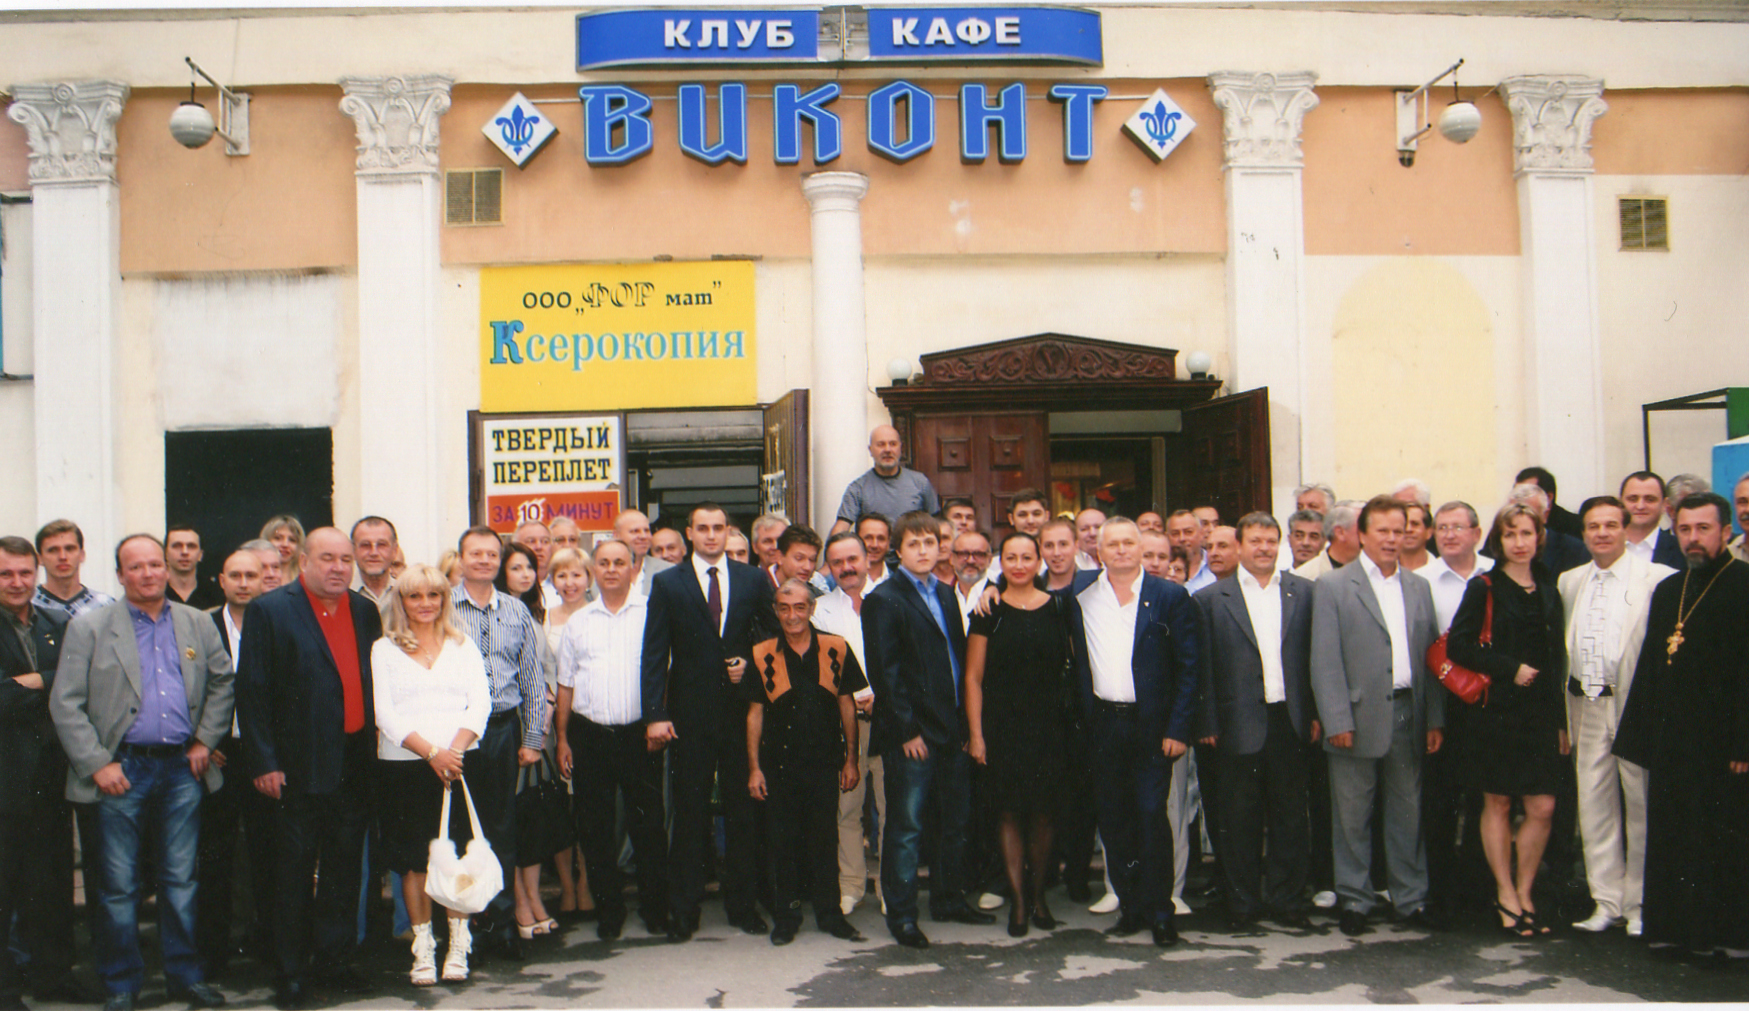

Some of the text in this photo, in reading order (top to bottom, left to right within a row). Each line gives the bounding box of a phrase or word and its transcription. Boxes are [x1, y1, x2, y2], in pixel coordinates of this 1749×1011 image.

[664, 19, 796, 49] КЛУБ
[892, 16, 1023, 46] КАФЕ
[578, 80, 1109, 164] ВИКОНТ
[522, 291, 572, 309] ООО
[489, 319, 745, 371] Ксерокопия
[492, 424, 610, 453] ТВЕРДЫЙ
[493, 458, 611, 484] ПЕРЕПЛЕТ
[493, 502, 613, 523] ЗА 10 МИНУТ
